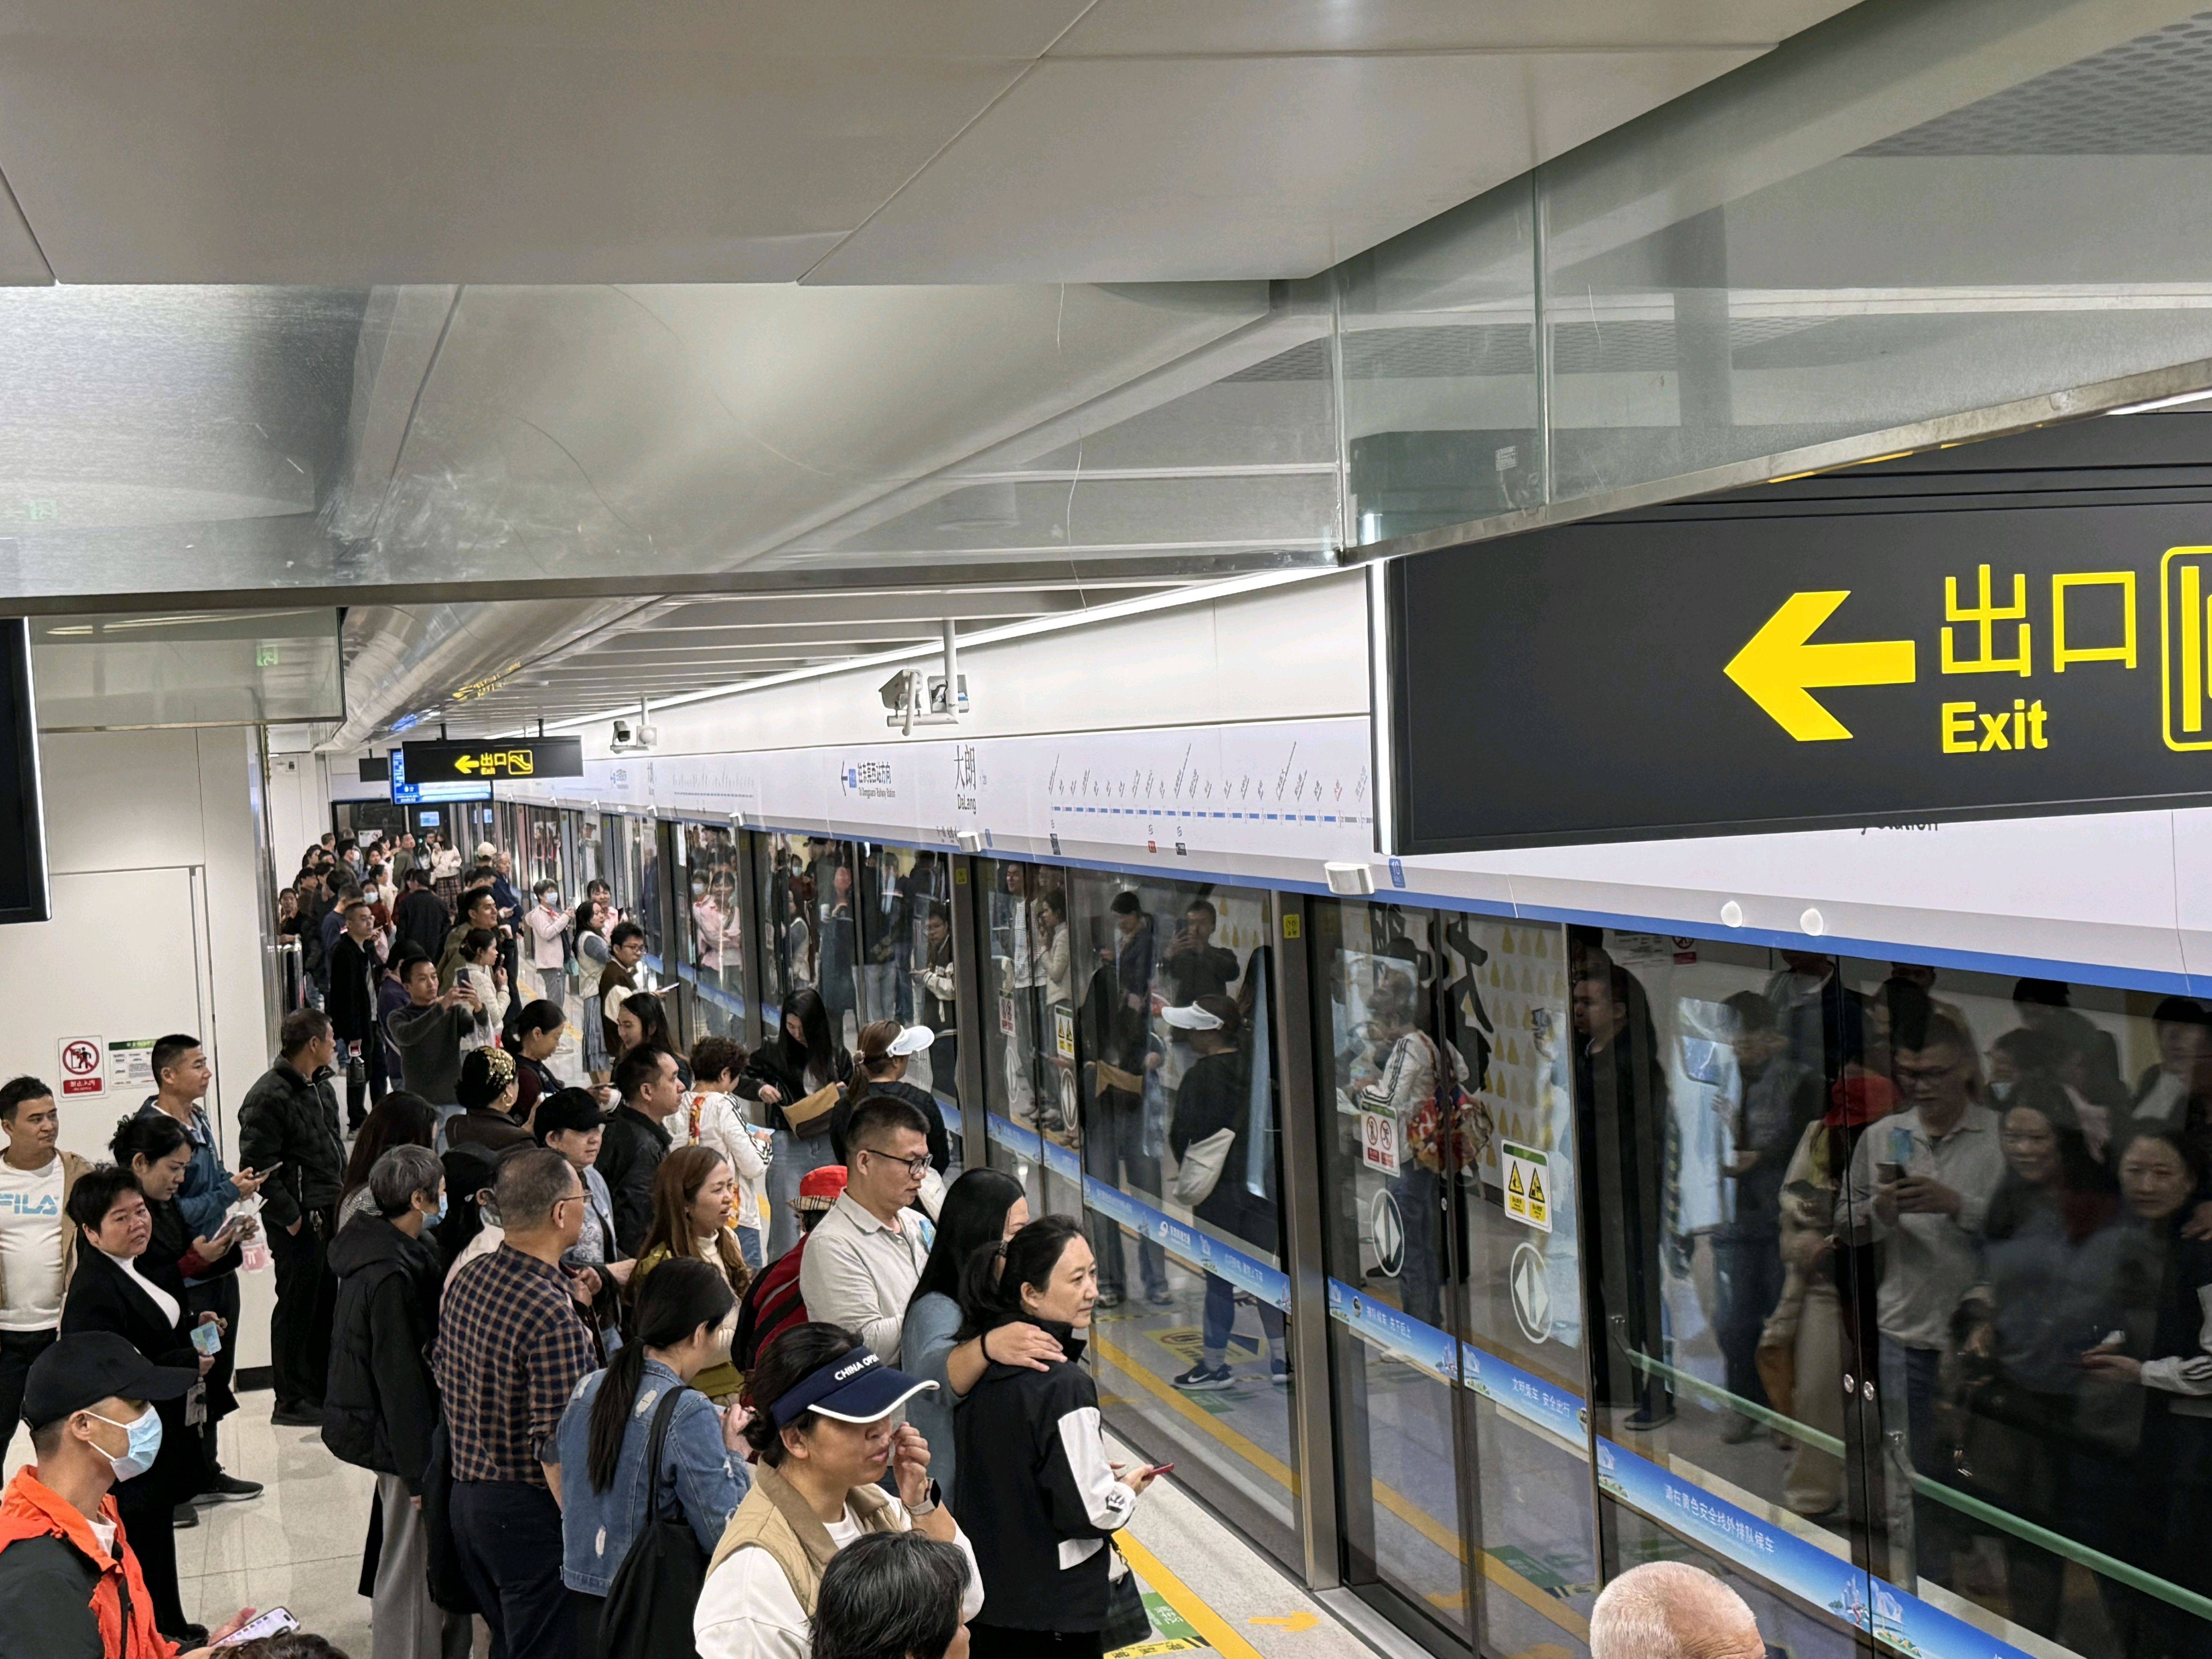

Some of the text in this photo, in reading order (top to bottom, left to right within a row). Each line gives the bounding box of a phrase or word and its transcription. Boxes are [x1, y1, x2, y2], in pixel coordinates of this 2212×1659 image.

[1941, 564, 2138, 677] 出口
[1942, 699, 2048, 753] Exit
[480, 753, 507, 766] 出口
[1391, 861, 1400, 876] 10
[0, 1193, 58, 1215] FILA
[835, 1361, 864, 1381] CHINA
[1512, 1377, 1571, 1418] 文明乘车 安全出行
